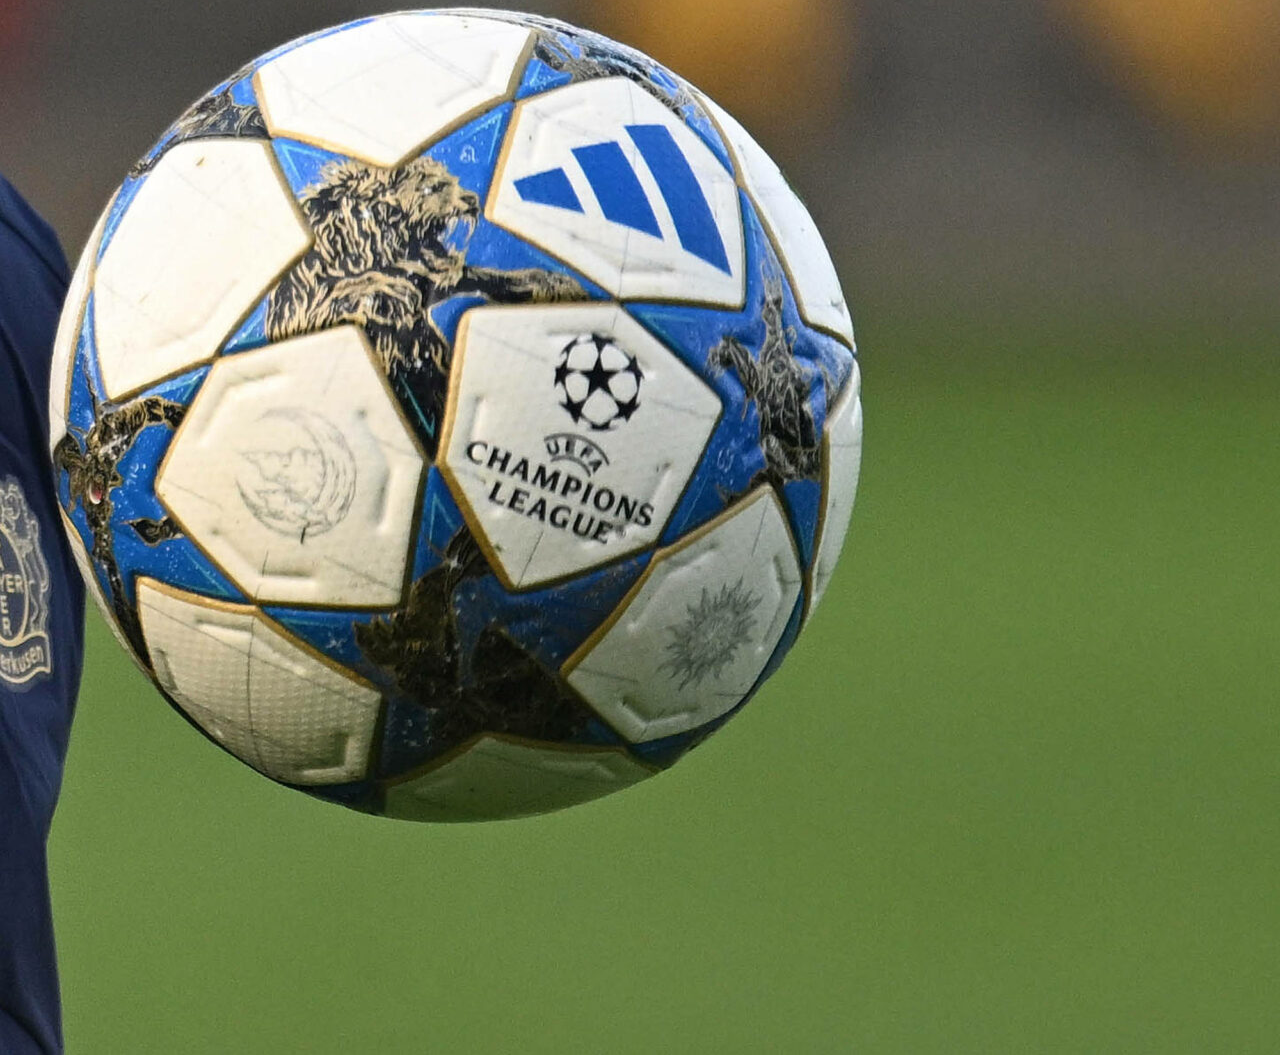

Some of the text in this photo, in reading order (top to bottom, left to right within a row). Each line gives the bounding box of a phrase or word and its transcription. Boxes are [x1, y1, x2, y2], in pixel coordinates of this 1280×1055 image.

[466, 441, 655, 527] CHAMPIONS
[545, 438, 603, 474] UEFA
[488, 481, 614, 544] LEAGUE
